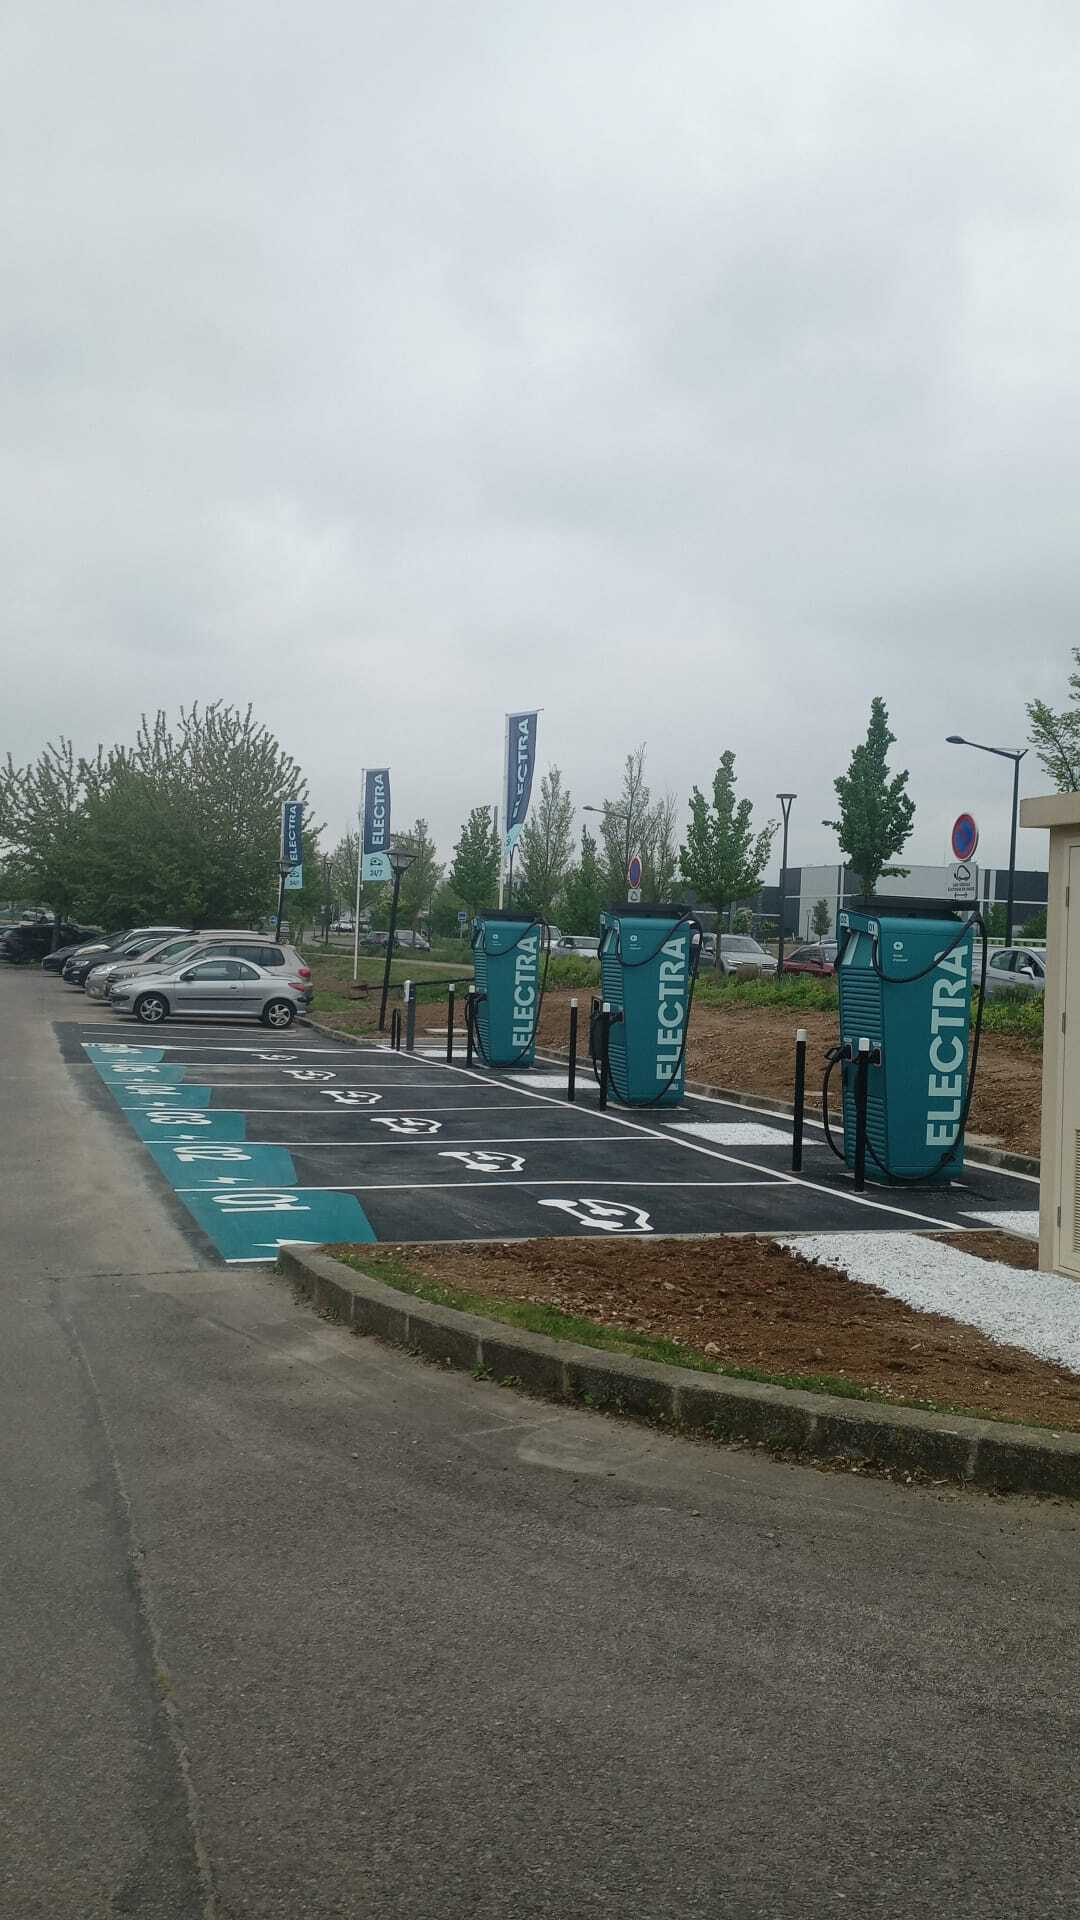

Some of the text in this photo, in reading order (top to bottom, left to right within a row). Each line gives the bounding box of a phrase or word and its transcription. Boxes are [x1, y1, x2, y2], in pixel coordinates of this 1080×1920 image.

[289, 805, 298, 861] ELECTRA
[371, 774, 384, 846] ELECTRA
[868, 923, 876, 932] 01
[512, 936, 537, 1047] ELECTRA
[656, 937, 686, 1080] ELECTRA
[926, 945, 967, 1146] ELECTRA
[145, 1111, 213, 1126] 03
[172, 1145, 253, 1162] 02
[211, 1193, 312, 1214] 01
